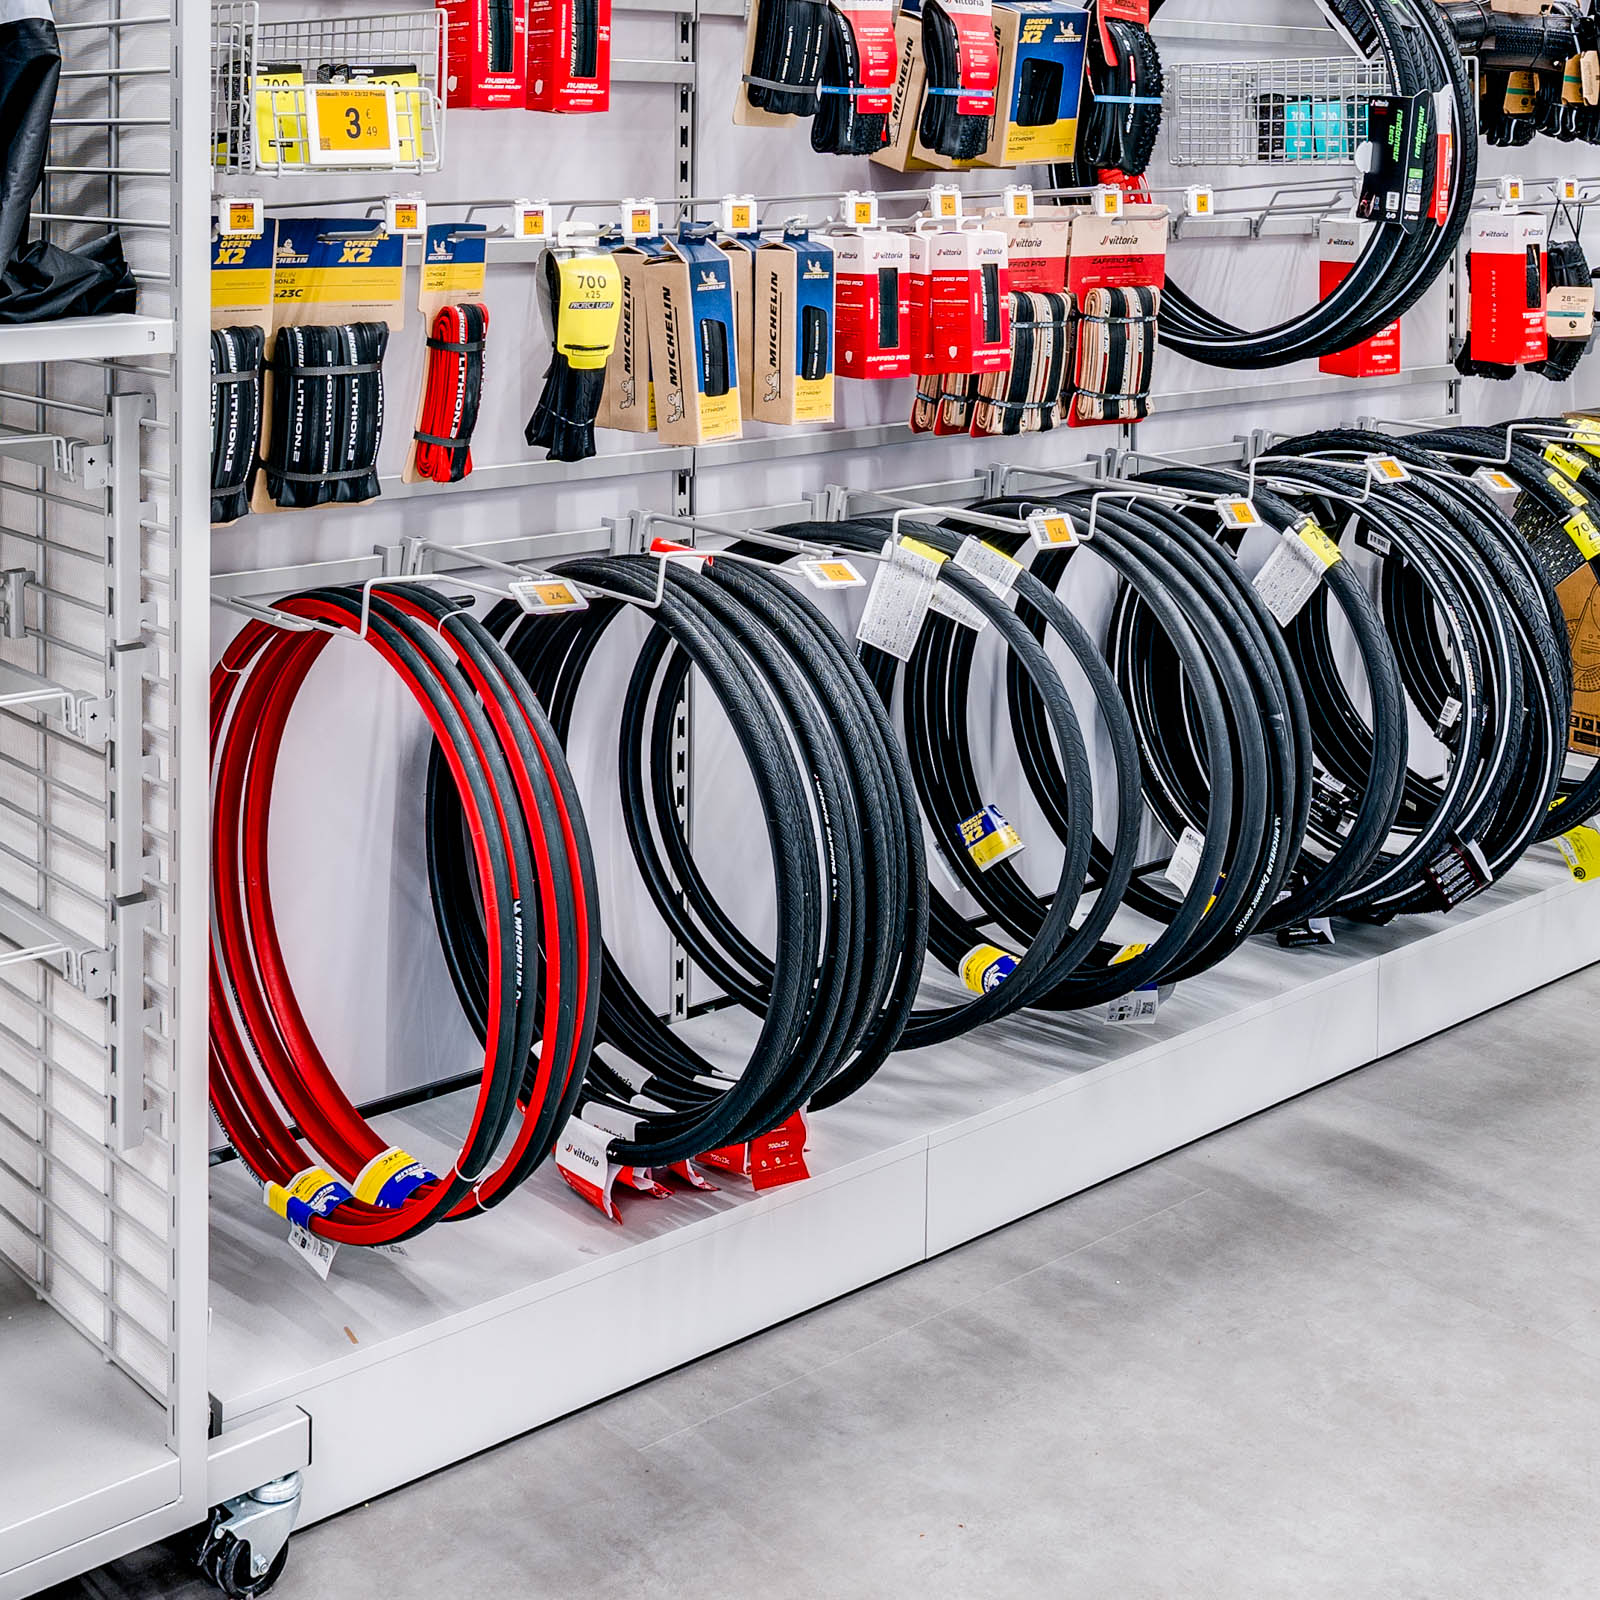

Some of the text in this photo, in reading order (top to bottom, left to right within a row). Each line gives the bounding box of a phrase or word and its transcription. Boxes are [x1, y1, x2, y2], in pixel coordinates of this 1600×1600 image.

[892, 36, 914, 120] MICHELIN
[344, 107, 371, 139] 3 €
[366, 126, 378, 137] 49
[1413, 105, 1425, 160] randonneur
[1387, 124, 1396, 146] tech
[1391, 108, 1404, 164] randonneur
[220, 240, 252, 248] OFFER
[344, 239, 378, 248] OFFER
[1015, 237, 1042, 248] vittoria
[1109, 235, 1138, 245] vittoria
[213, 248, 247, 265] X2
[338, 247, 374, 264] X2
[1091, 257, 1126, 265] ZAFFIRO
[576, 274, 608, 290] 700
[568, 301, 614, 310] PROTECT LIGHT
[623, 276, 632, 375] MICHELIN
[769, 271, 778, 368] MICHELIN
[662, 286, 679, 387] MICHELIN
[224, 383, 239, 472] LITHION.2
[292, 379, 305, 462] LITHION.2
[347, 378, 359, 461] LITHION.2
[959, 809, 987, 829] SPECIAL
[961, 818, 983, 835] OFFER
[965, 824, 985, 846] X2
[513, 915, 524, 990] MICHELIN
[573, 1146, 600, 1168] vittoria
